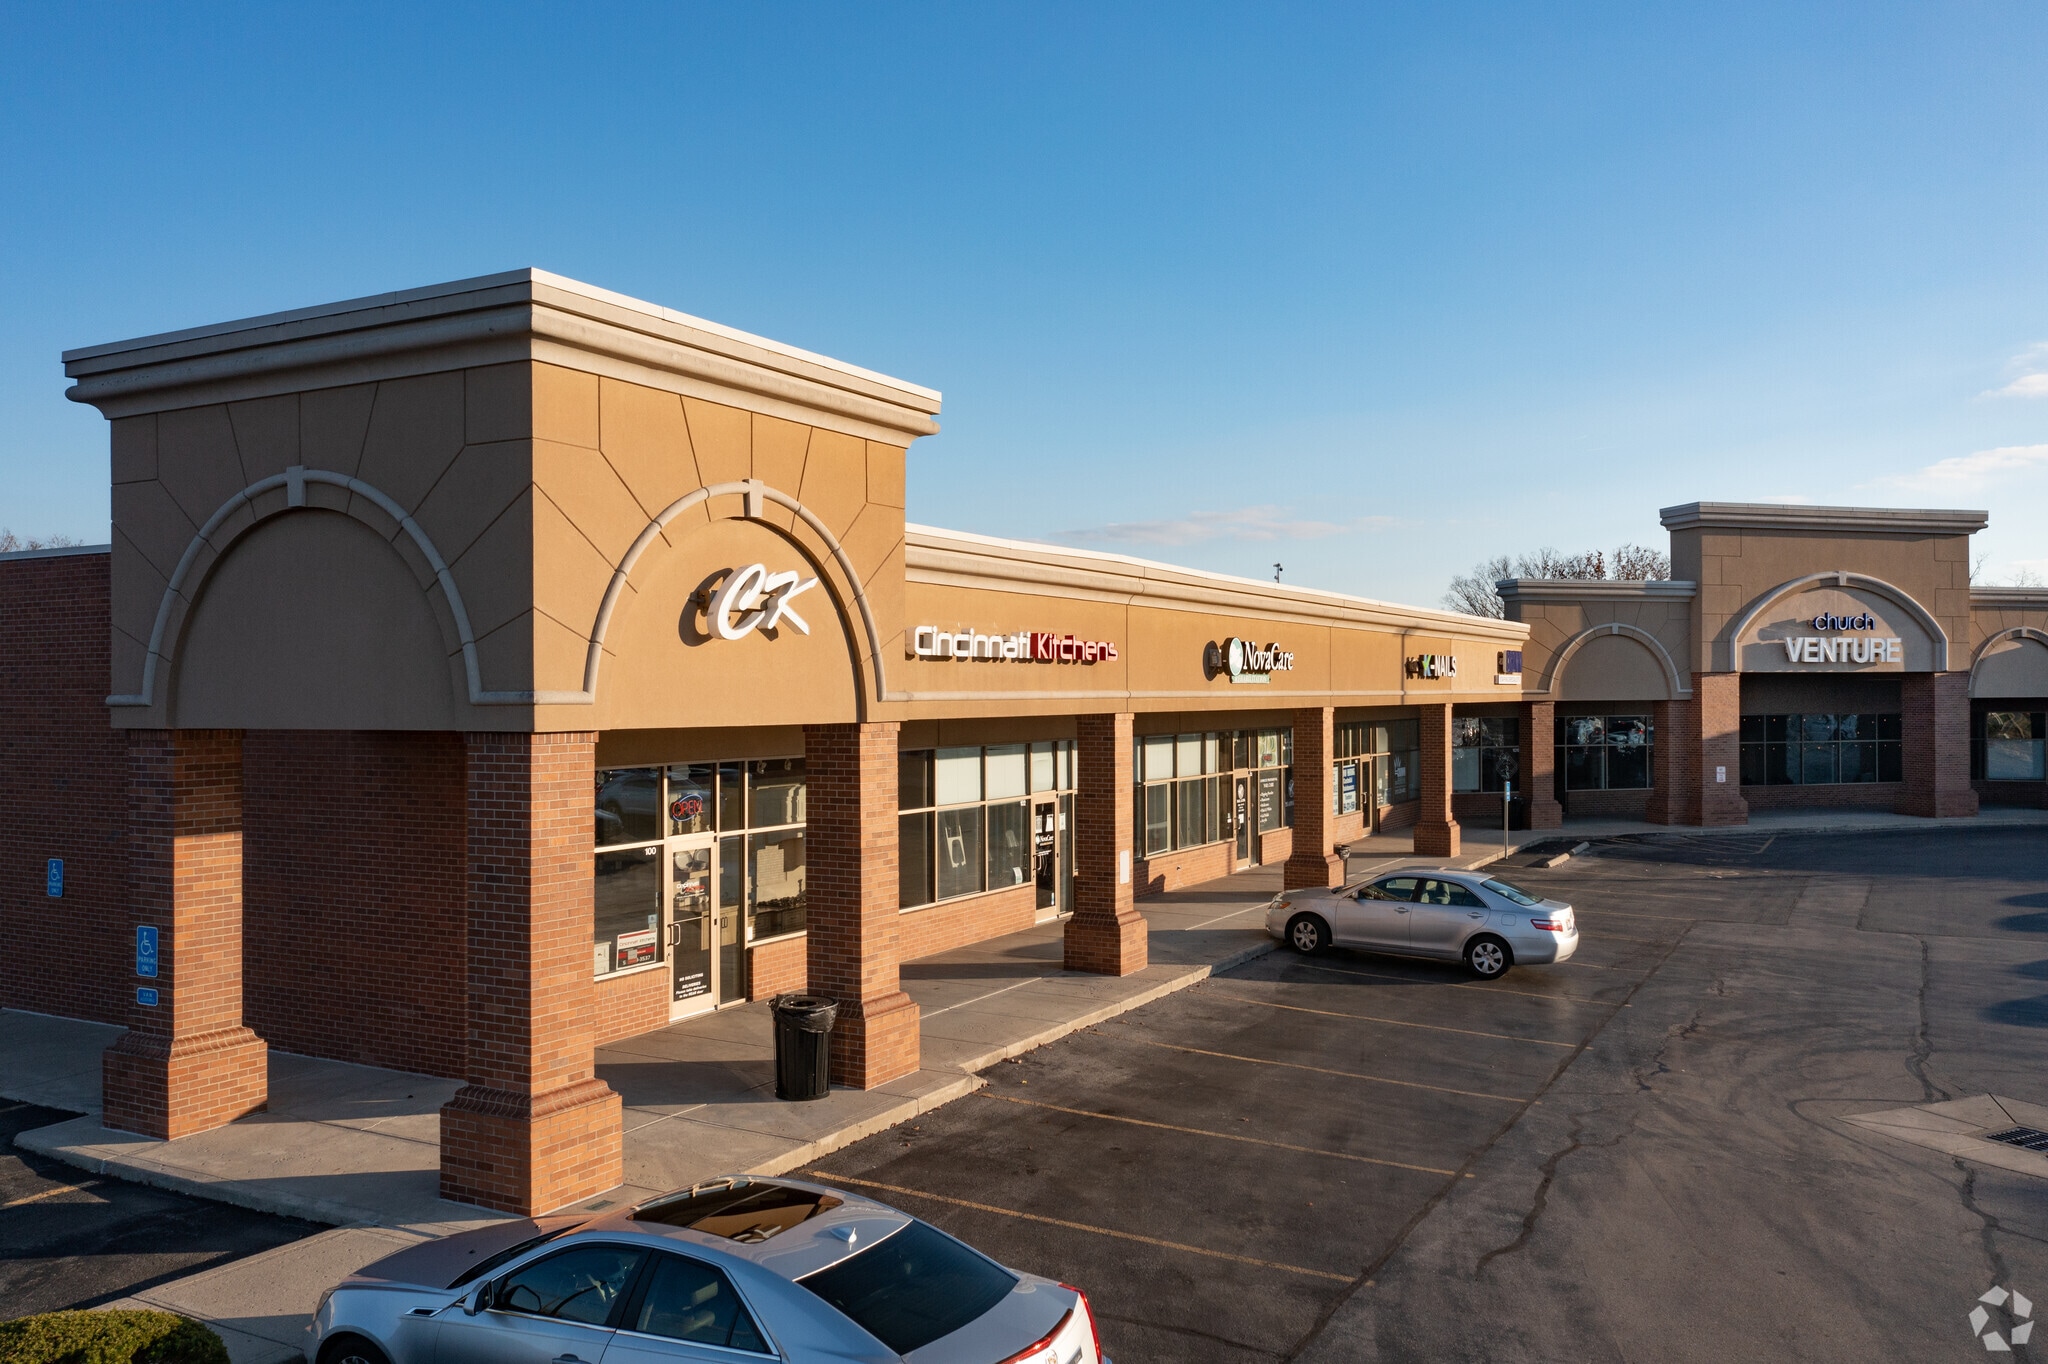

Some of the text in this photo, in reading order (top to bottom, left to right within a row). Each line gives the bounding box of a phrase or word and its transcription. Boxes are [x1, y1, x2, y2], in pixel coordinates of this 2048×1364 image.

[1813, 612, 1876, 631] church
[910, 625, 1119, 662] Cincinnati Kitchens
[1785, 636, 1902, 663] VENTURE
[1243, 640, 1294, 671] NovaCare
[1422, 653, 1457, 677] K-NAILS
[671, 799, 703, 817] OPEN
[645, 847, 657, 856] 100
[138, 956, 157, 964] PARKING
[141, 964, 153, 972] ONLY
